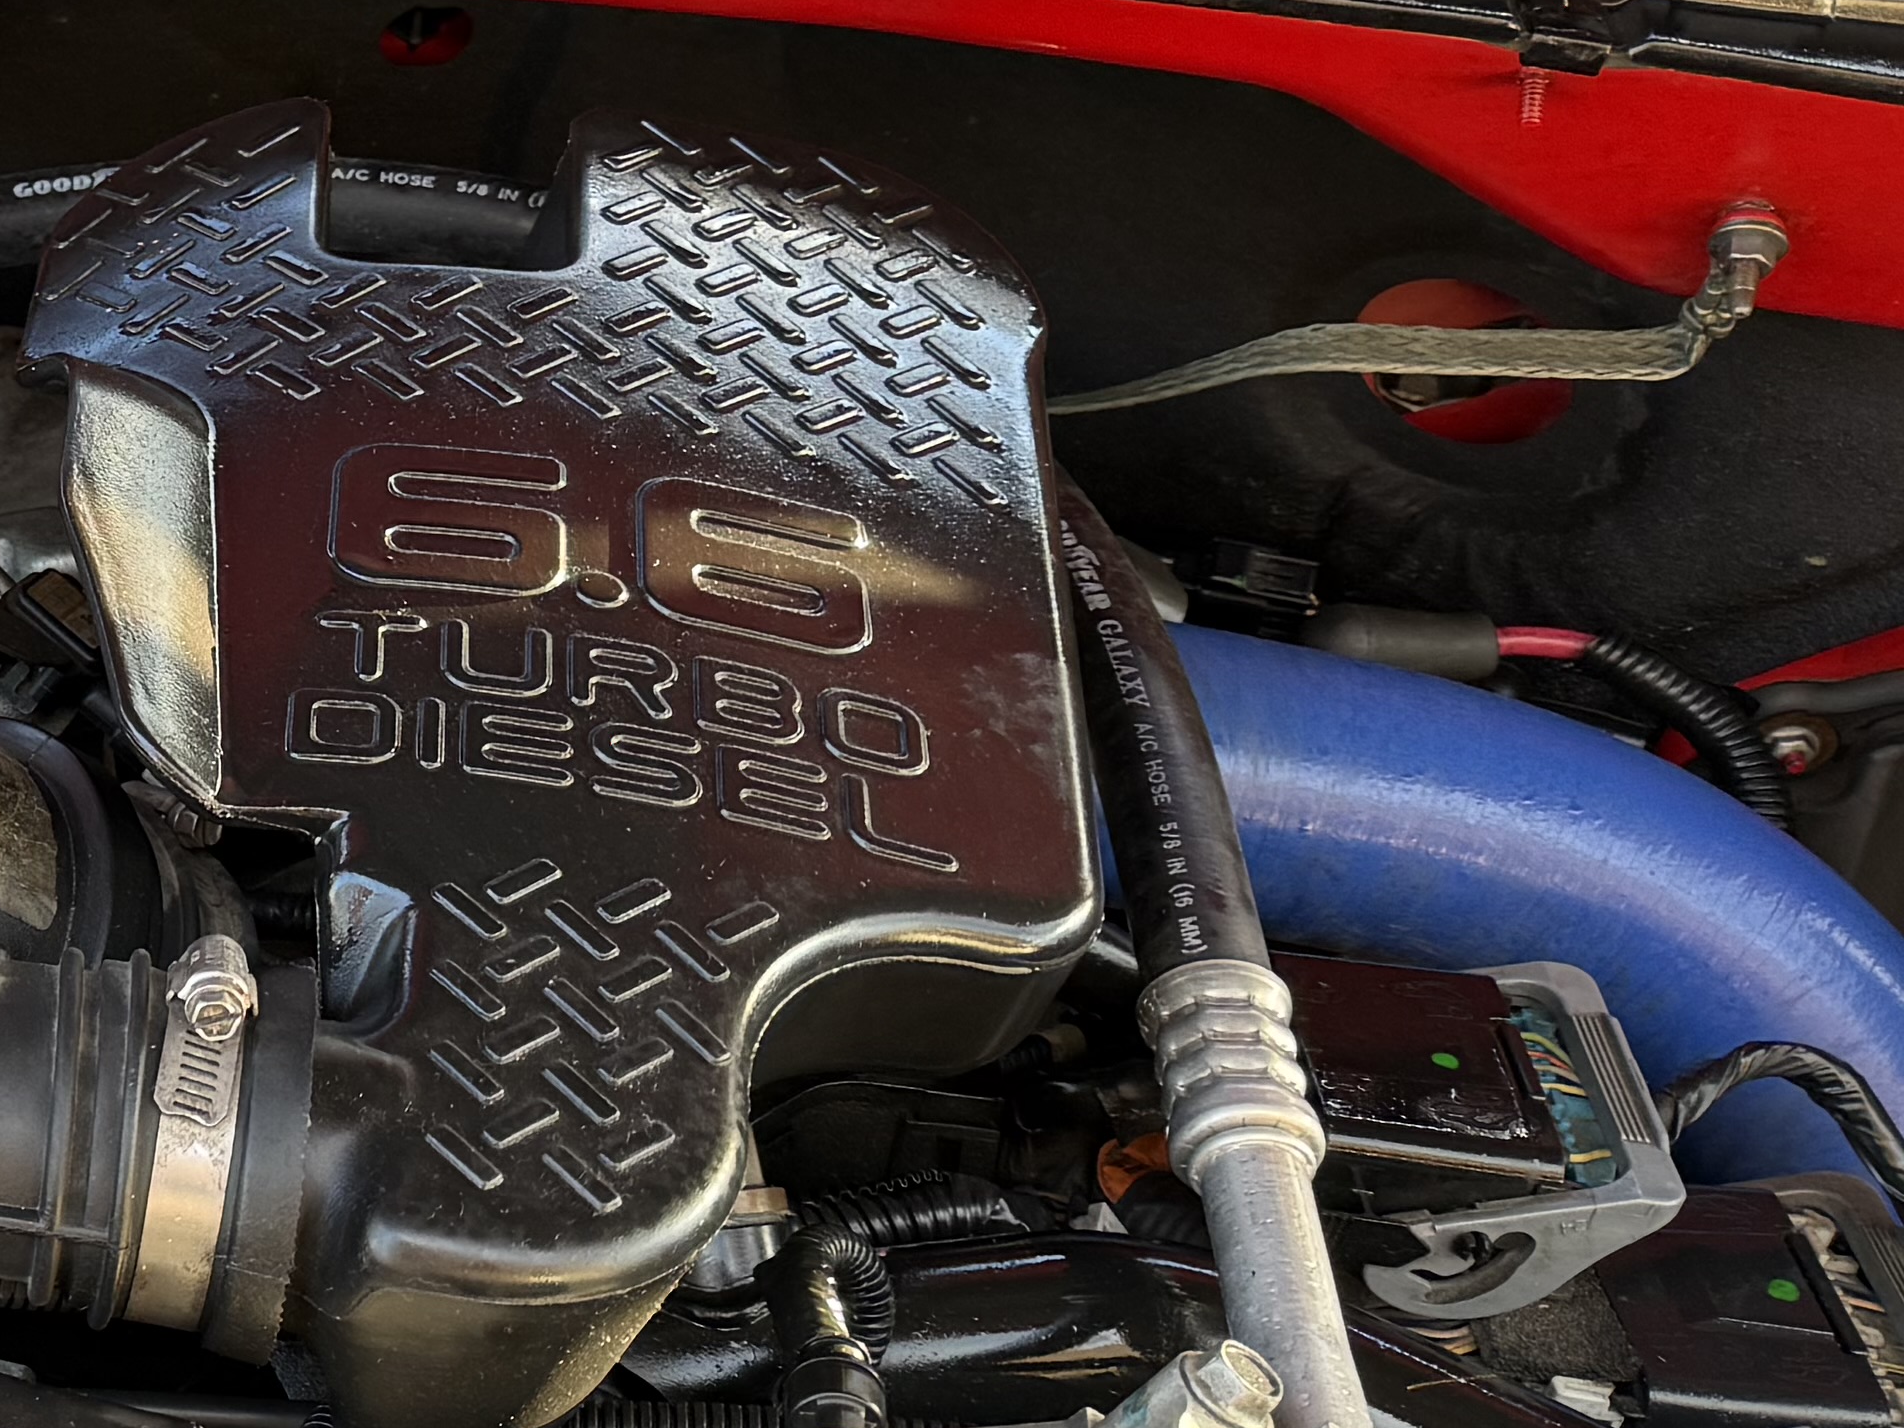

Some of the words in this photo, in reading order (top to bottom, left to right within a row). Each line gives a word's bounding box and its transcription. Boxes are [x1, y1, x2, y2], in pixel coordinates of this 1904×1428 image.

[330, 167, 370, 181] A/C
[379, 170, 437, 189] HOSE
[455, 179, 491, 198] 5/8
[496, 184, 519, 202] IN
[325, 441, 875, 658] 6.6
[1096, 619, 1152, 708] GALAXY
[317, 610, 931, 776] TURBO
[1133, 722, 1159, 752] A/C
[285, 685, 960, 874] DIESEL
[1143, 759, 1173, 806] HOSE
[1159, 821, 1183, 850] 5/8
[1166, 856, 1189, 876] IN
[1168, 882, 1196, 909] (16
[1178, 915, 1209, 956] MM)
